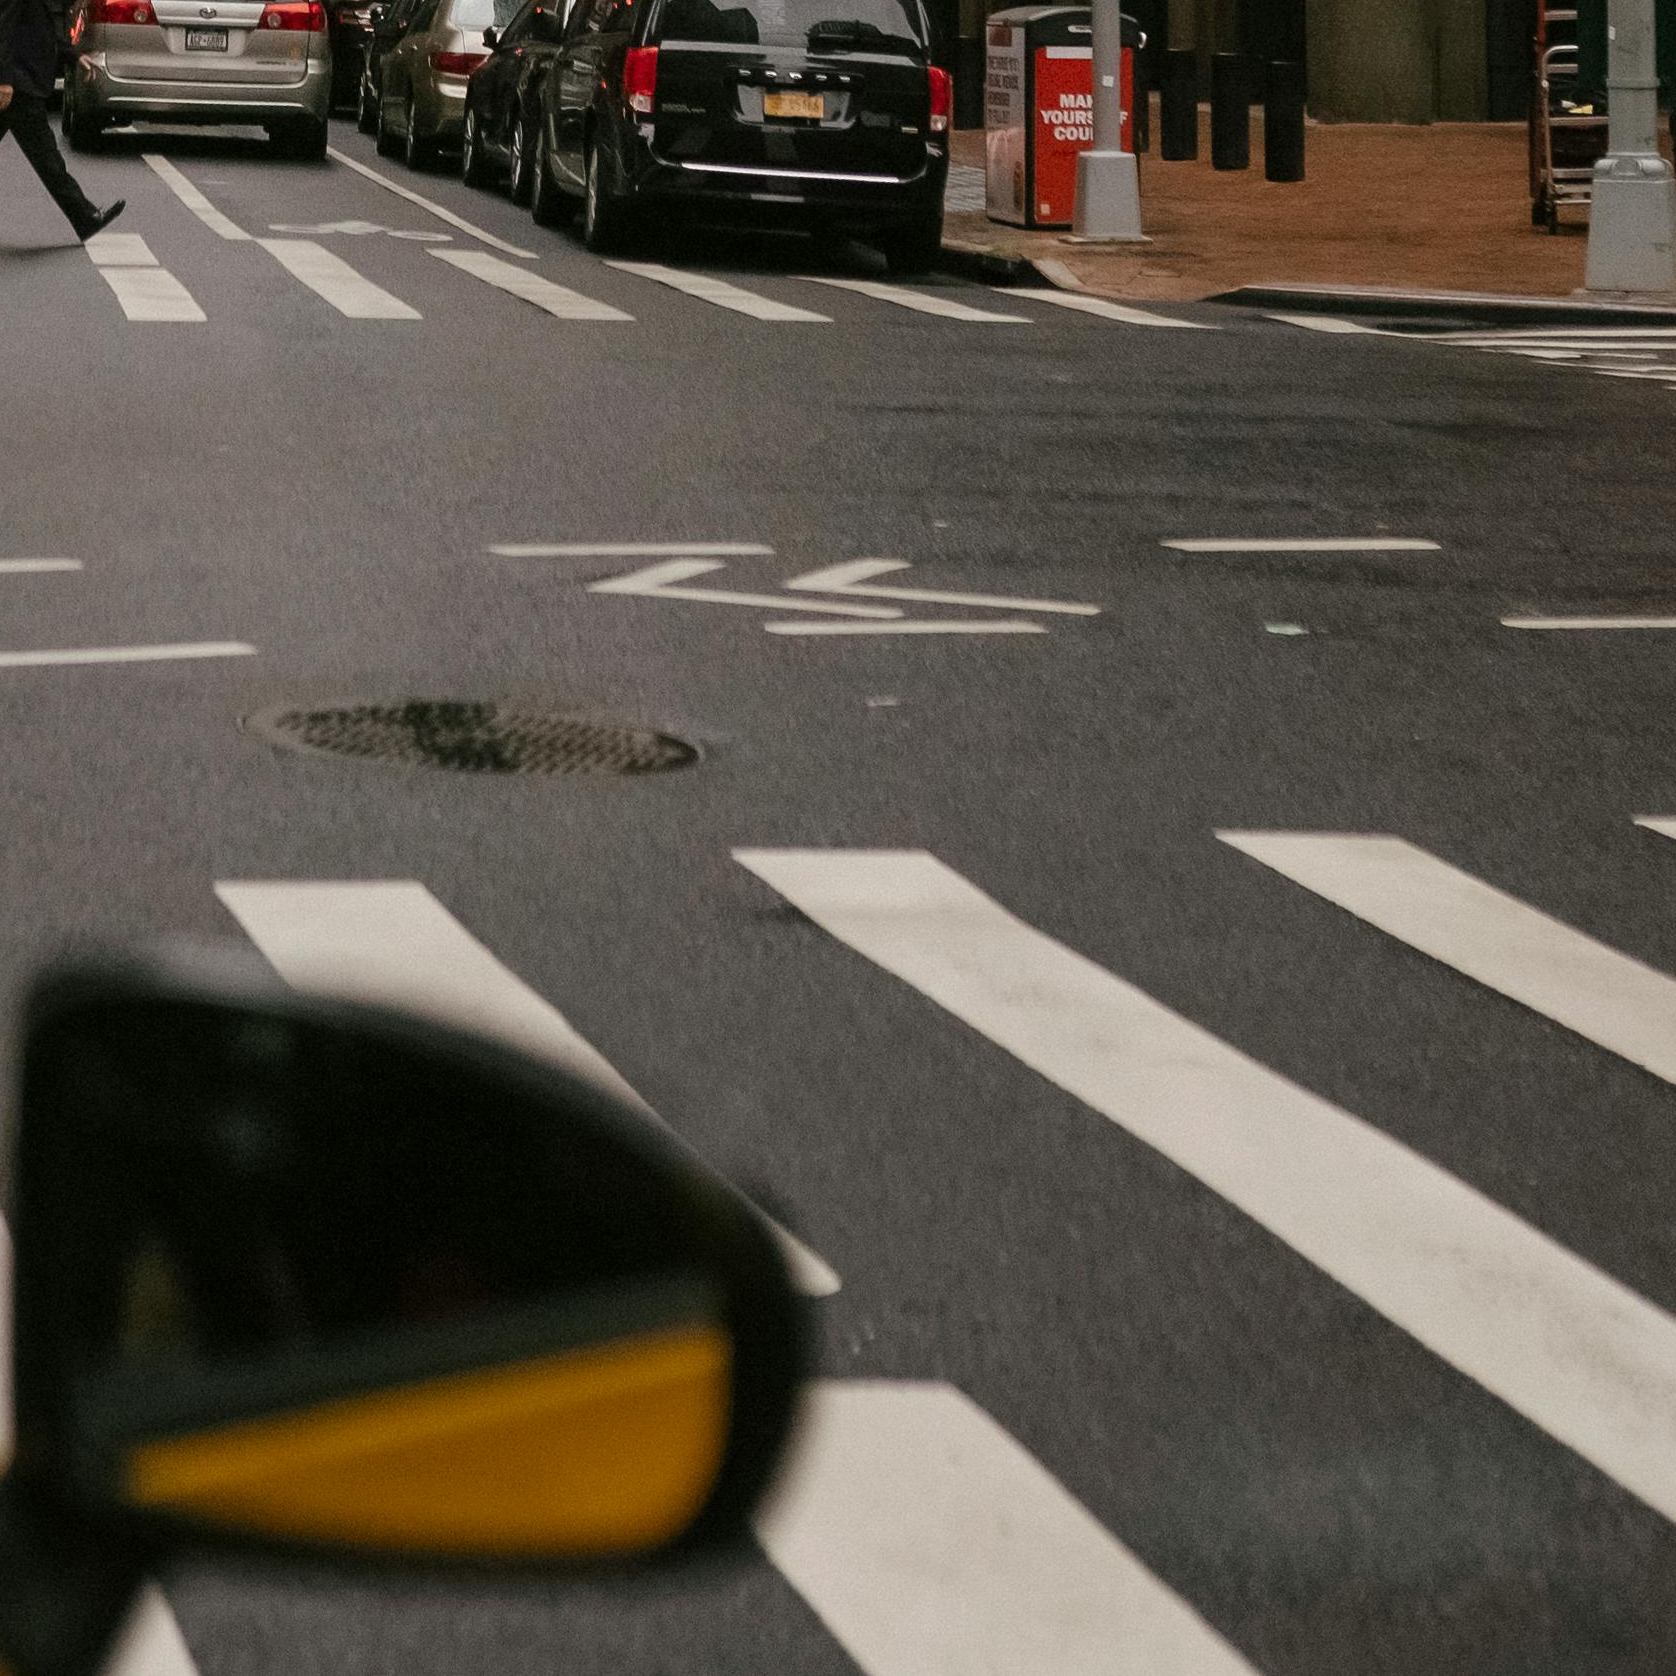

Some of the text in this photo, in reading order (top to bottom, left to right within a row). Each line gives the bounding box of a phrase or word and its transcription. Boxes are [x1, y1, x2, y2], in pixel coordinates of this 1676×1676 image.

[1059, 94, 1093, 108] MA
[1040, 110, 1128, 126] YOURSF
[1054, 127, 1093, 142] COU
